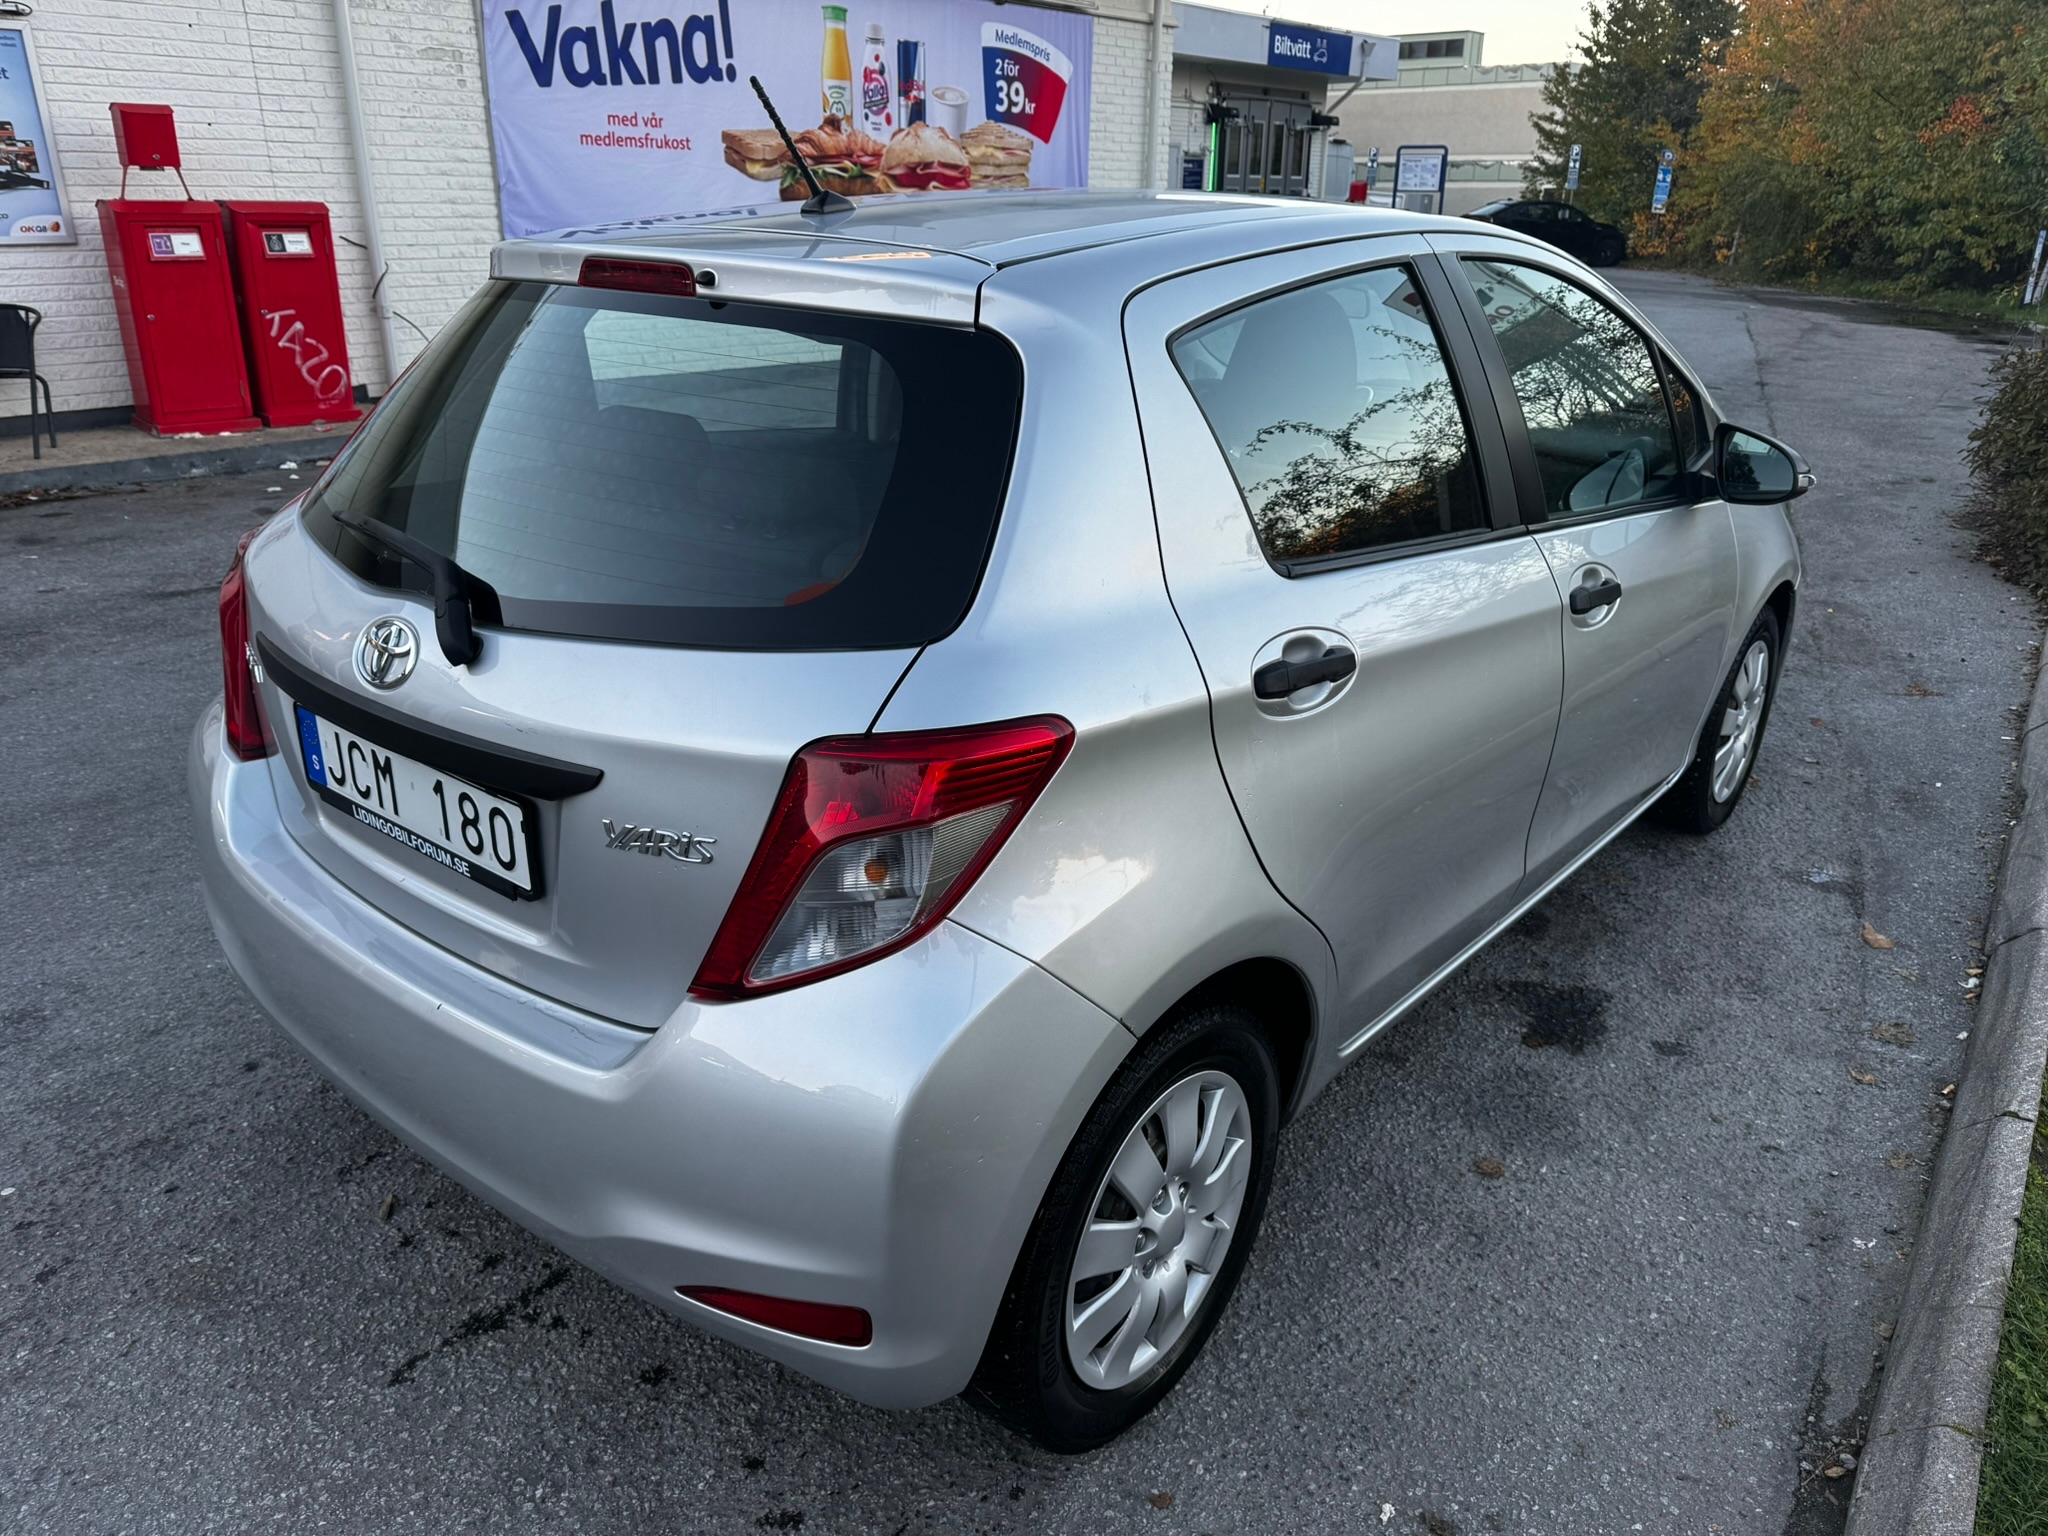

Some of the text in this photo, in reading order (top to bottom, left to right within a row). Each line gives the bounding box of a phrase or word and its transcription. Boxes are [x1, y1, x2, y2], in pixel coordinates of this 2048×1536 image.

[505, 0, 737, 88] Vakna!
[995, 28, 1051, 62] Medlemspris
[1274, 34, 1312, 58] Biltvätt
[995, 58, 1020, 76] 2 för
[994, 79, 1036, 114] 39 kr
[607, 112, 664, 128] med vår
[580, 131, 692, 151] medlemsfrukost
[20, 225, 48, 233] OKQ8
[312, 754, 321, 771] S
[327, 731, 517, 872] JCM 180
[352, 804, 472, 878] LIDINGOBILFORUM.SE
